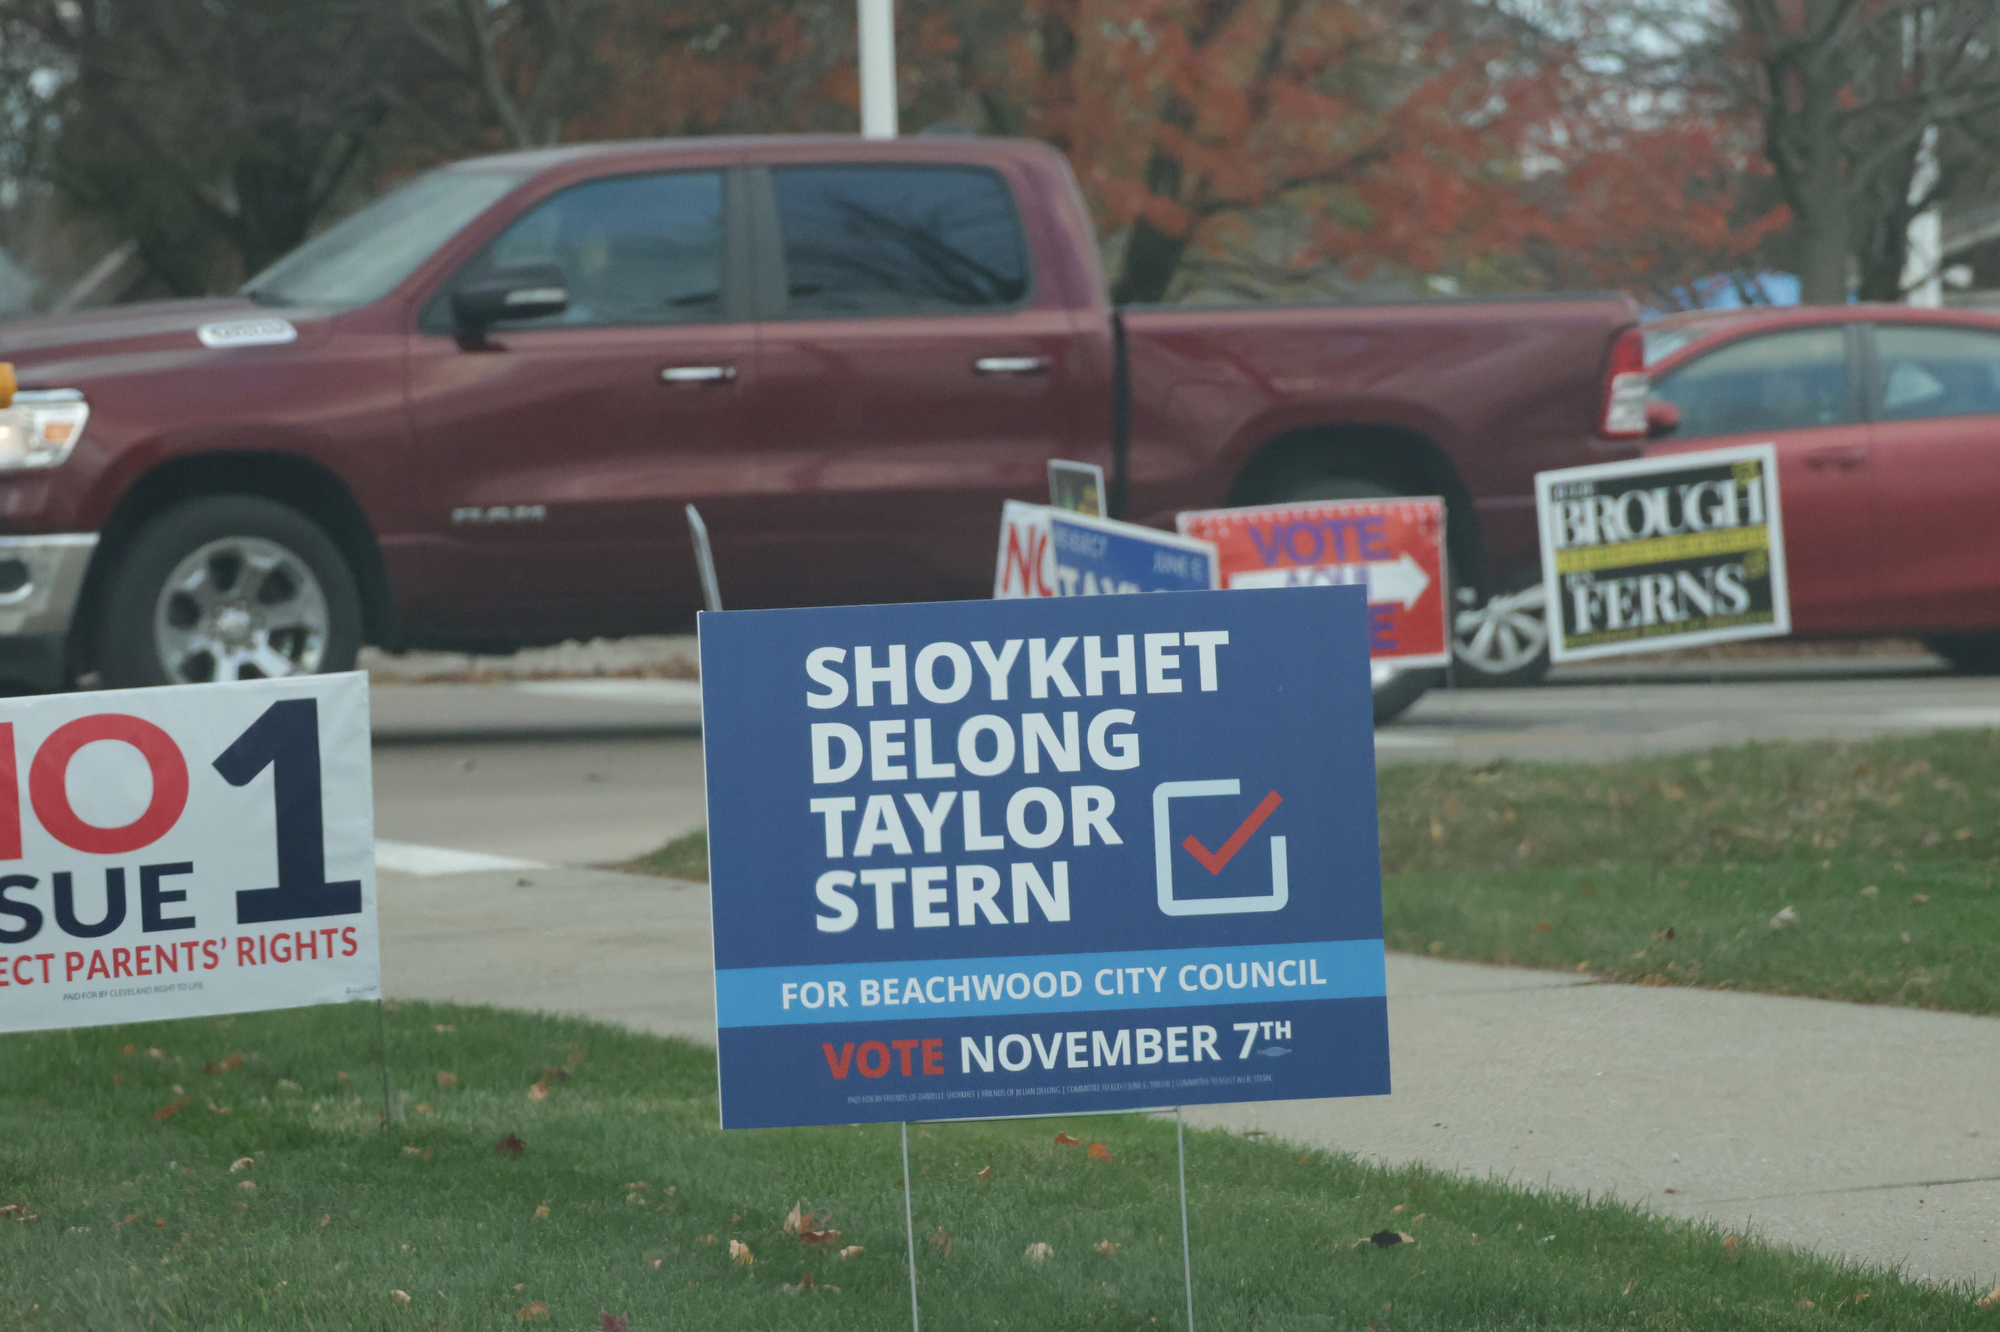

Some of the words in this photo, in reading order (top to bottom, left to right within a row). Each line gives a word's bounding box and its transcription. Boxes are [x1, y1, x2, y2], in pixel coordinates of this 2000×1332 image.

[1247, 516, 1390, 567] VOTE
[1550, 476, 1765, 549] BROUGH
[1569, 563, 1750, 635] FERNS
[806, 630, 1230, 710] SHOYKHET
[810, 708, 1140, 784] DELONG
[0, 713, 190, 861] O
[212, 697, 362, 925] 1
[809, 785, 1124, 858] TAYLOR
[815, 860, 1071, 933] STERN
[236, 926, 358, 967] RIGHTS
[63, 993, 81, 1001] PAID
[82, 991, 97, 999] FOR
[99, 991, 108, 999] BY
[110, 986, 152, 997] CLEVELAND
[782, 979, 849, 1010] FOR
[860, 970, 1083, 1008] BEACHWOOD
[1094, 966, 1168, 997] CITY
[1178, 958, 1327, 992] COUNCIL
[822, 1038, 945, 1080] VOTE
[960, 1026, 1221, 1074] NOVEMBER
